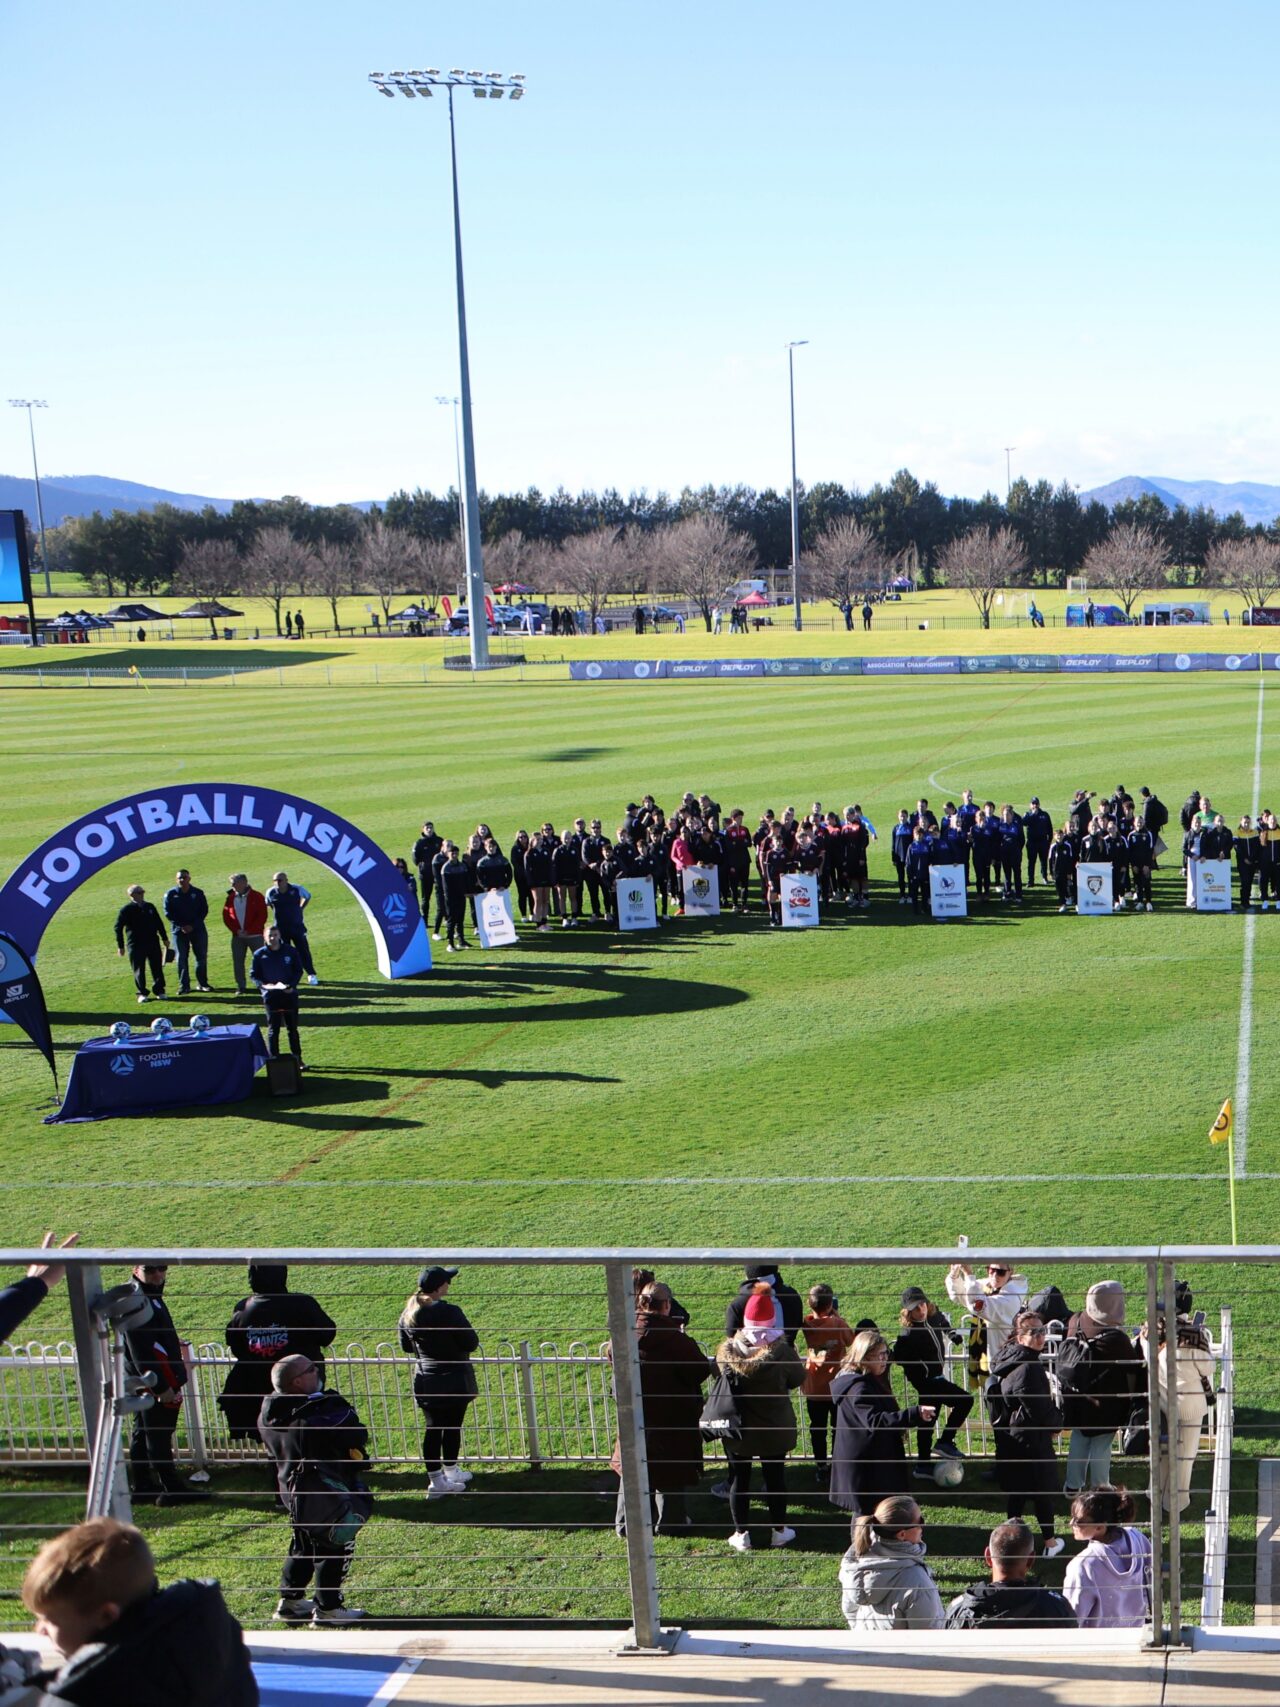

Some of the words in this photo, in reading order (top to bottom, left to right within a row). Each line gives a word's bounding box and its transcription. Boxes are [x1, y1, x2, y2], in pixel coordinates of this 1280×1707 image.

[18, 793, 263, 908] FOOTBALL
[274, 804, 376, 880] NSW
[4, 993, 30, 1004] DEPLOY
[140, 1051, 182, 1061] FOOTBALL
[150, 1058, 171, 1068] NSW
